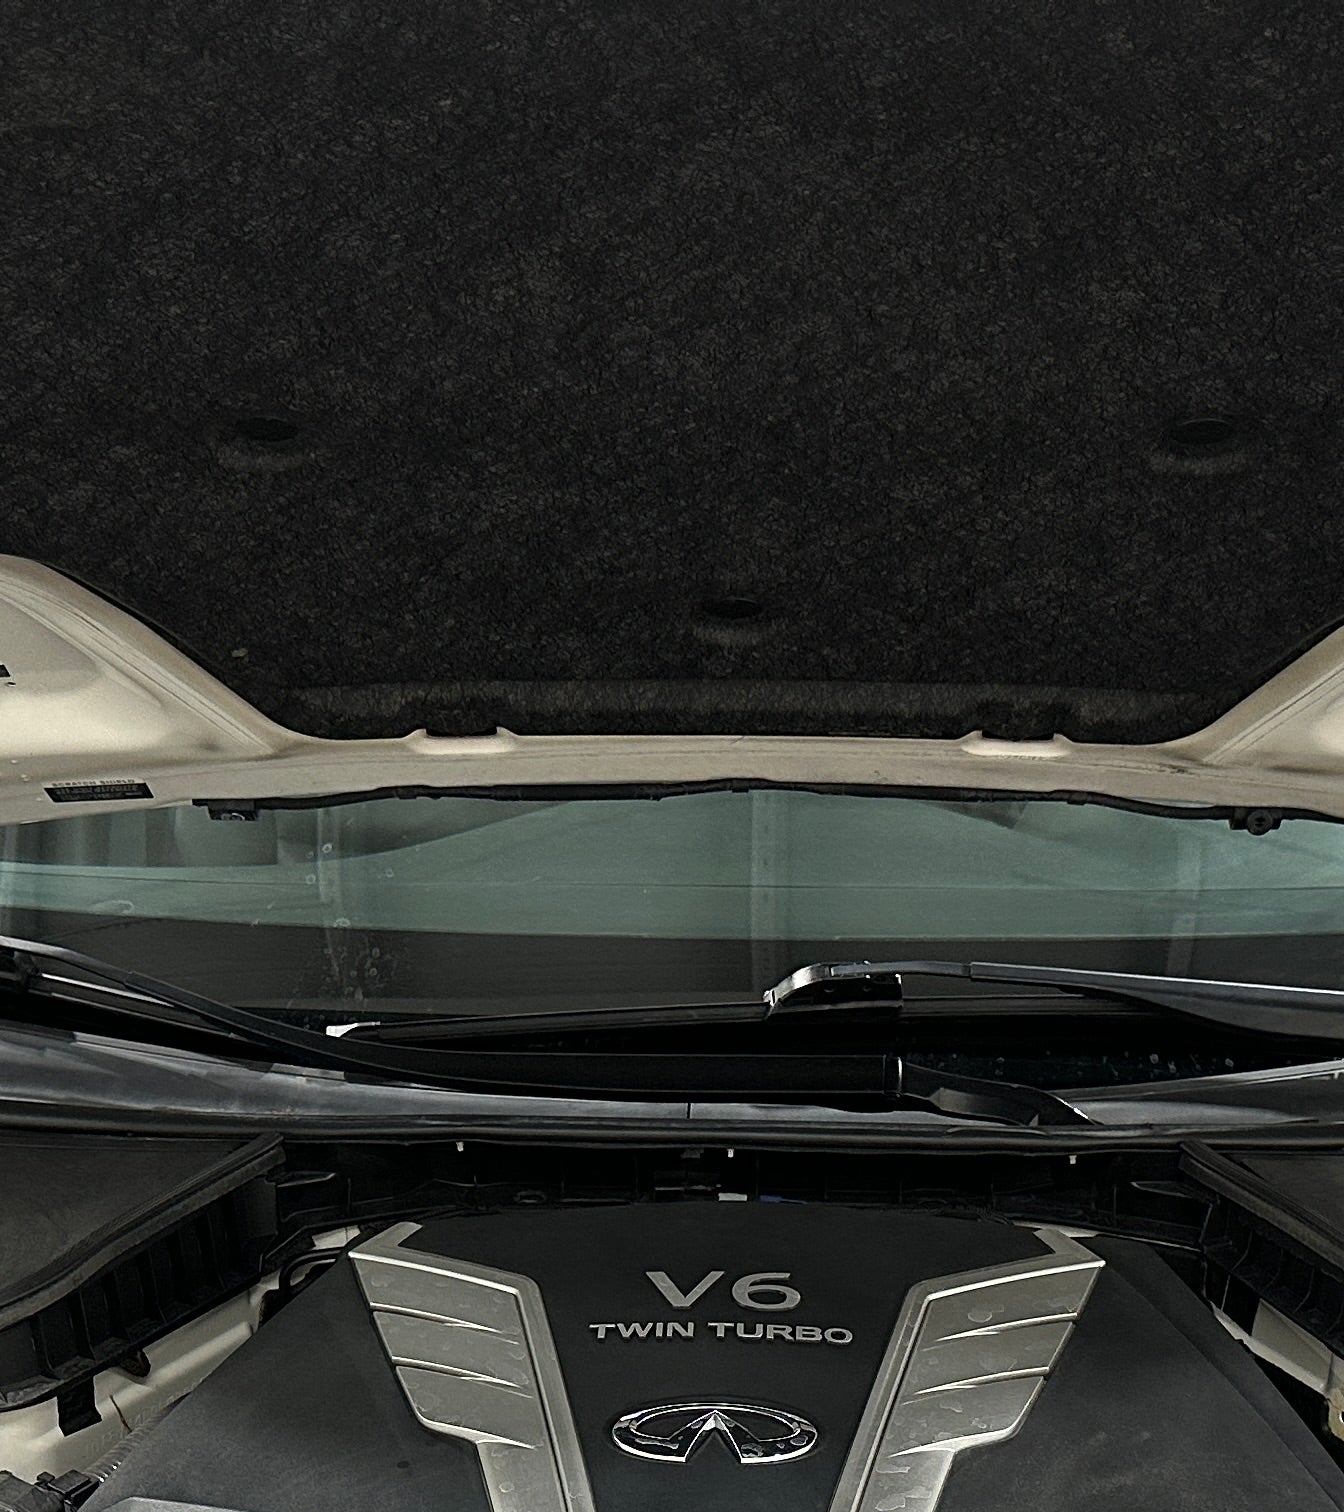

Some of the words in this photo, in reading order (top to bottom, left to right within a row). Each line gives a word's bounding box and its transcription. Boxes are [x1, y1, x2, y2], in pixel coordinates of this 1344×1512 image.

[645, 1270, 802, 1311] V6
[588, 1321, 695, 1340] TWIN
[707, 1321, 854, 1344] TURBO
